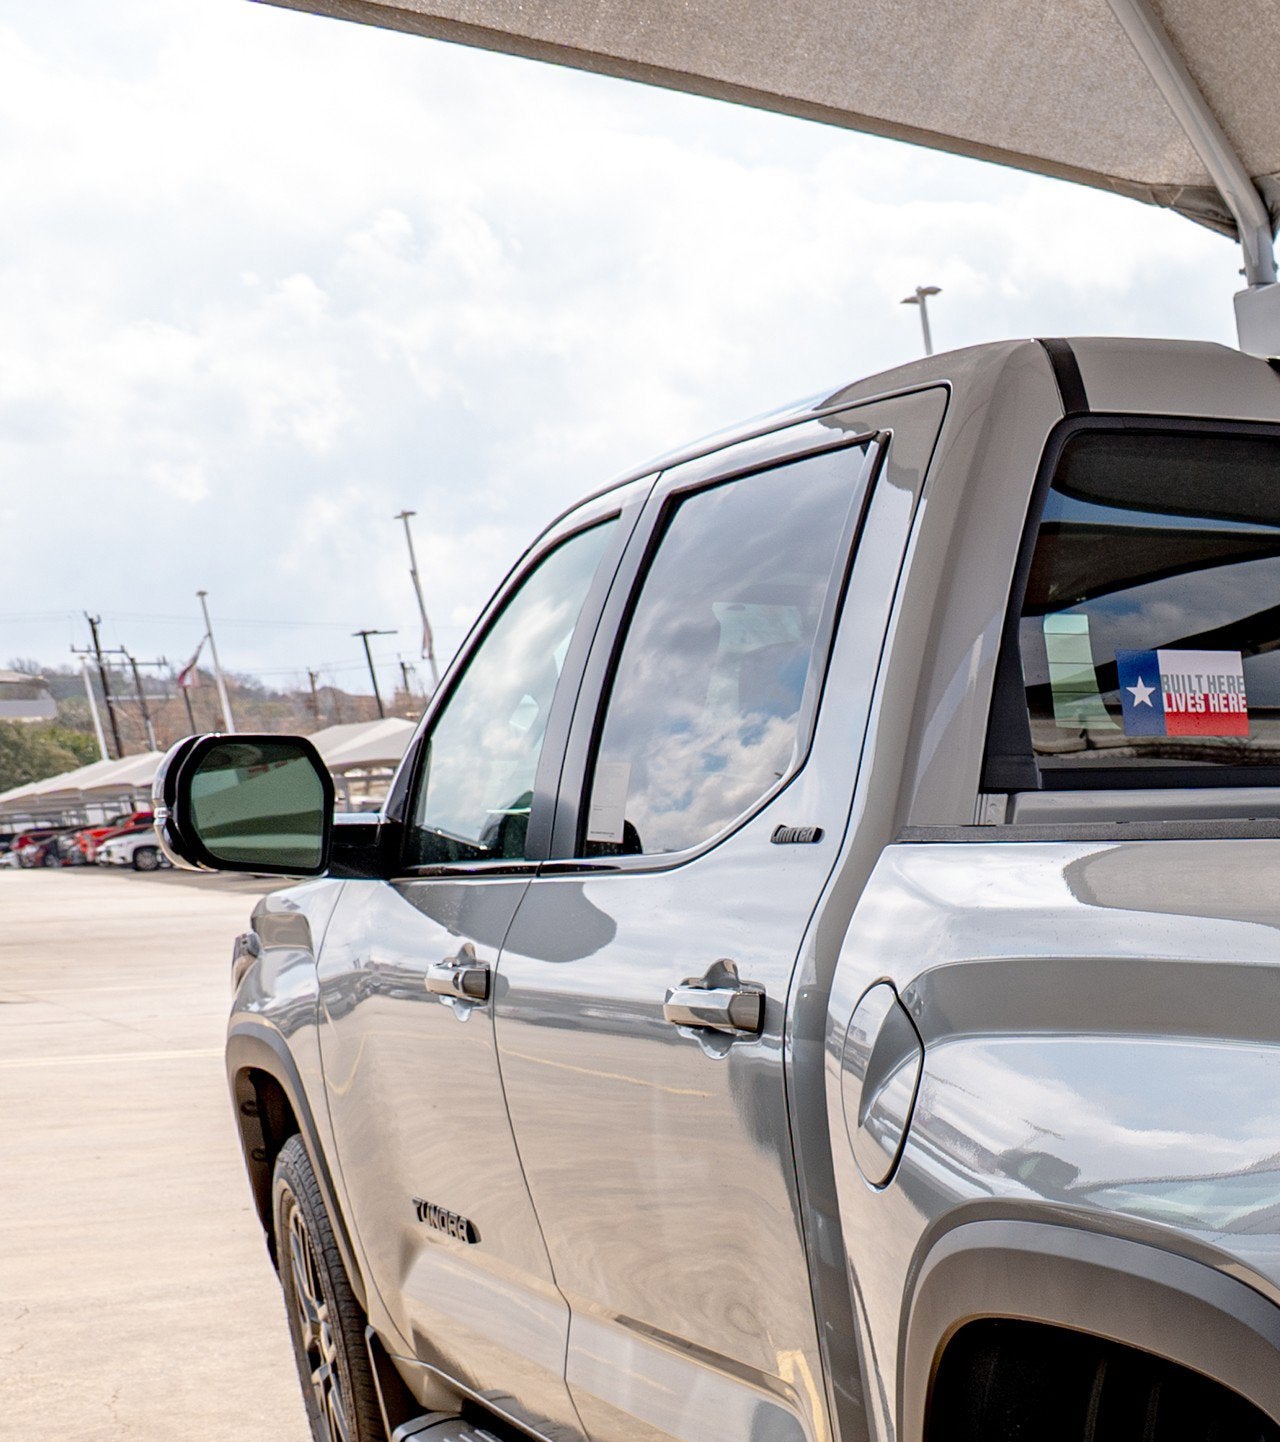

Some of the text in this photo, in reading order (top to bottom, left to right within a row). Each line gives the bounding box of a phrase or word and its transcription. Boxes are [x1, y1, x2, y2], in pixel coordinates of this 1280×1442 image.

[1161, 673, 1246, 695] BUILT HERE
[1163, 692, 1248, 714] LIVES HERE
[412, 1196, 482, 1244] TUNDRA
